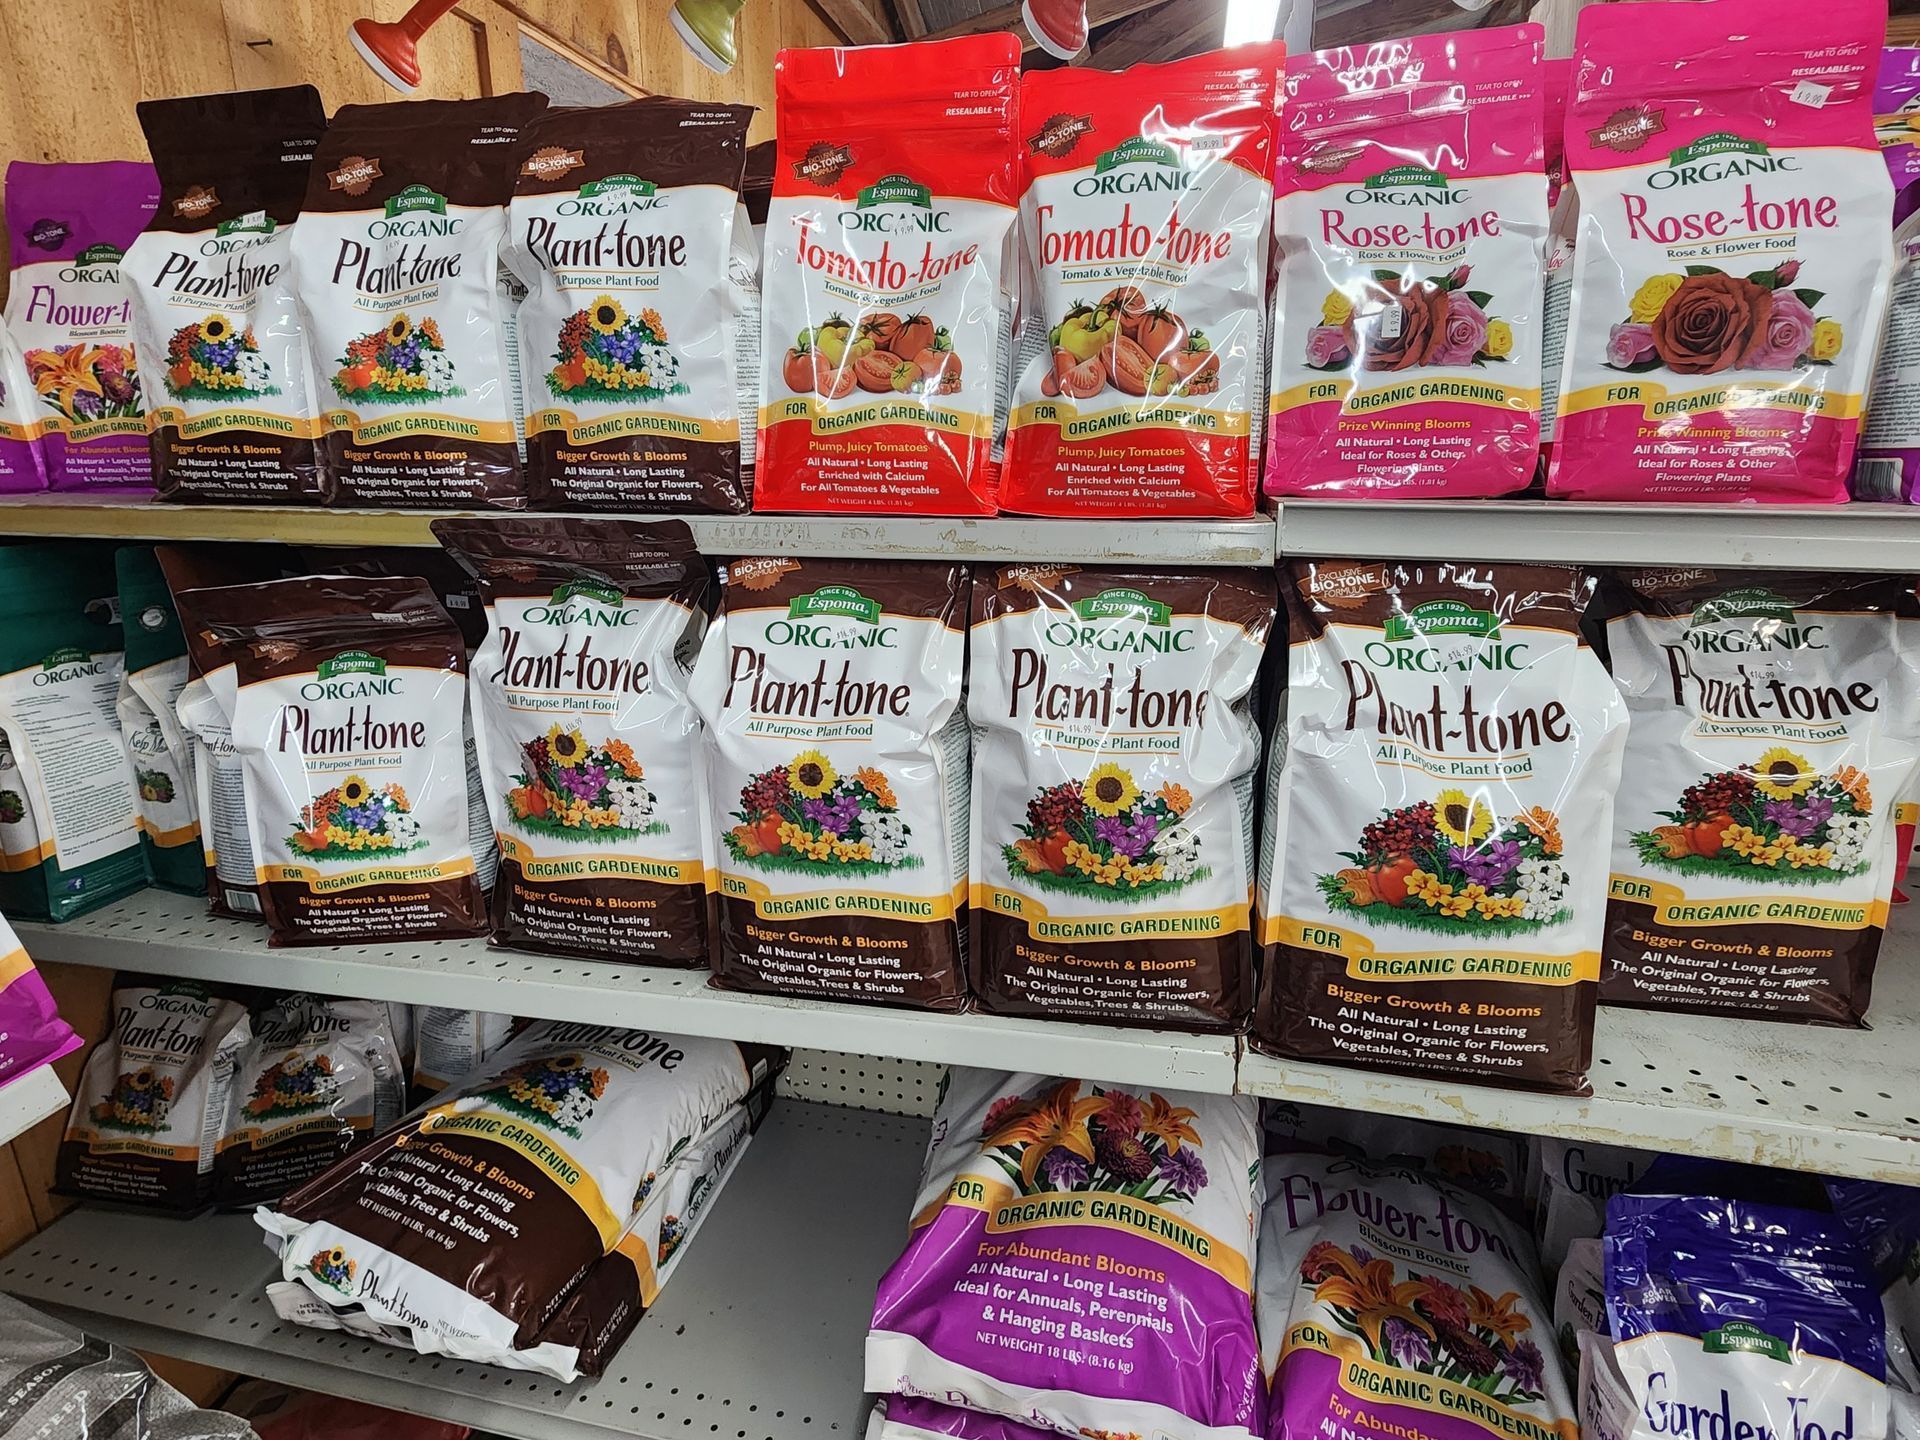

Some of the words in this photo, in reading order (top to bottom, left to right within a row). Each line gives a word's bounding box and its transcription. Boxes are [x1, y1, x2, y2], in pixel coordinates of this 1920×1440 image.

[1792, 65, 1850, 76] RESEALABLE
[980, 89, 998, 97] OPEN
[946, 106, 993, 116] RESEALABLE
[1111, 147, 1166, 162] Espoma
[1687, 140, 1749, 156] Espoma
[802, 153, 846, 175] BIO-TONE
[1647, 157, 1801, 190] ORGANIC
[871, 186, 919, 199] Espoma
[1073, 172, 1202, 197] ORGANIC
[397, 196, 436, 208] Espoma
[557, 196, 670, 216] ORGANIC
[1345, 189, 1472, 206] ORGANIC
[1620, 184, 1839, 243] Rose-tone
[368, 219, 463, 240] ORGANIC
[1037, 203, 1231, 269] Tomato-tone
[1320, 208, 1502, 249] Rose-tone
[525, 216, 687, 271] Plant-tone
[790, 214, 978, 290] Tomato-tone
[1667, 248, 1696, 259] Rose
[1701, 248, 1712, 257] &
[1715, 241, 1760, 255] Flower
[1764, 237, 1797, 249] Food
[153, 252, 280, 299] Plant-tone
[332, 238, 461, 294] Plant-tone
[1061, 269, 1100, 280] Tomato
[1103, 267, 1112, 277] &
[1116, 266, 1164, 279] Vegetable
[1165, 272, 1188, 283] Food
[26, 285, 132, 326] Flower-t
[355, 297, 370, 306] All
[372, 299, 401, 310] Purpose
[404, 295, 420, 305] Plant
[422, 289, 439, 300] Food
[182, 414, 222, 435] ORGANIC
[224, 412, 293, 433] GARDENING
[1338, 420, 1368, 432] Prize
[1370, 419, 1418, 432] Winning
[1422, 418, 1471, 430] Blooms
[171, 445, 194, 455] Bigger
[197, 445, 230, 454] Growth
[233, 446, 240, 454] &
[244, 445, 281, 454] Blooms
[809, 441, 846, 454] Plump,
[847, 441, 874, 454] Juicy
[875, 441, 929, 453] Tomatoes
[1638, 459, 1666, 469] Ideal
[1669, 459, 1683, 469] for
[1686, 459, 1722, 469] Roses
[1726, 459, 1735, 469] &
[1738, 459, 1776, 469] Other
[551, 479, 567, 489] The
[570, 479, 607, 491] Original
[608, 479, 642, 491] Organic
[644, 479, 658, 489] for
[661, 479, 703, 491] Flowers,
[1067, 476, 1109, 486] Enriched
[1111, 476, 1134, 486] with
[1136, 476, 1181, 486] Calcium
[1655, 472, 1711, 484] Flowering
[1715, 472, 1751, 483] Plants
[800, 483, 816, 494] For
[818, 484, 832, 494] All
[832, 484, 878, 495] Tomatoes
[880, 485, 889, 495] &
[890, 485, 940, 497] Vegetables
[1310, 572, 1375, 593] BIO-TONE
[1324, 586, 1366, 597] FORMULA
[806, 597, 866, 612] Espoma
[1419, 602, 1443, 613] SINCE
[1446, 603, 1465, 612] 1929
[523, 605, 637, 628] ORGANIC
[1405, 614, 1478, 630] Espoma
[1046, 623, 1193, 653] ORGANIC
[1365, 641, 1529, 671] ORGANIC
[33, 661, 107, 687] ORGANIC
[723, 645, 911, 718] Plant-tone
[300, 678, 404, 702] ORGANIC
[1341, 659, 1571, 754] Plant-tone
[280, 704, 426, 755] Plant-tone
[746, 720, 763, 732] All
[766, 723, 813, 737] Purpose
[816, 725, 842, 737] Plant
[845, 724, 873, 736] Food
[723, 878, 747, 894] FOR
[1610, 879, 1653, 898] FOR
[763, 896, 830, 914] ORGANIC
[835, 895, 932, 916] GARDENING
[1667, 903, 1761, 920] ORGANIC
[1766, 903, 1864, 923] GARDENING
[1302, 927, 1342, 949] FOR
[1360, 958, 1455, 975] ORGANIC
[1462, 958, 1572, 978] GARDENING
[1327, 984, 1381, 1004] Bigger
[1387, 995, 1452, 1014] Growth
[1457, 1003, 1471, 1015] &
[1477, 1004, 1541, 1017] Blooms
[1632, 978, 1708, 996] Vegetables,
[1709, 987, 1745, 999] Trees
[1749, 990, 1759, 999] &
[1764, 990, 1810, 1002] Shrubs
[140, 995, 217, 1018] ORGANIC
[1337, 1006, 1358, 1020] All
[1362, 1011, 1419, 1028] Natural
[1433, 1021, 1470, 1036] Long
[1474, 1024, 1527, 1039] Lasting
[432, 1115, 498, 1138] ORGANIC
[500, 1119, 581, 1187] GARDENING
[431, 1142, 475, 1170] Growth
[475, 1159, 485, 1174] &
[487, 1166, 536, 1201] Blooms
[949, 1181, 985, 1203] FOR
[997, 1199, 1084, 1225] ORGANIC
[1090, 1201, 1210, 1258] GARDENING
[1280, 1174, 1528, 1277] Flower-ton
[1359, 1224, 1410, 1257] Blossom
[1416, 1247, 1470, 1274] Booster
[978, 1242, 1004, 1256] For
[1006, 1242, 1091, 1269] Abundant
[1096, 1254, 1166, 1284] Blooms
[358, 1269, 429, 1332] Plant-tone
[954, 1280, 989, 1296] Ideal
[993, 1285, 1015, 1301] for
[1017, 1288, 1085, 1317] Annuals,
[1089, 1301, 1174, 1334] Perennials
[1291, 1325, 1330, 1350] FOR
[1721, 1334, 1773, 1350] Espoma
[975, 1331, 997, 1345] NET
[998, 1335, 1044, 1356] WEIGHT
[1047, 1345, 1060, 1358] 18
[1088, 1354, 1115, 1371] (8.16
[1117, 1358, 1134, 1374] kg)
[1347, 1362, 1433, 1404] ORGANIC
